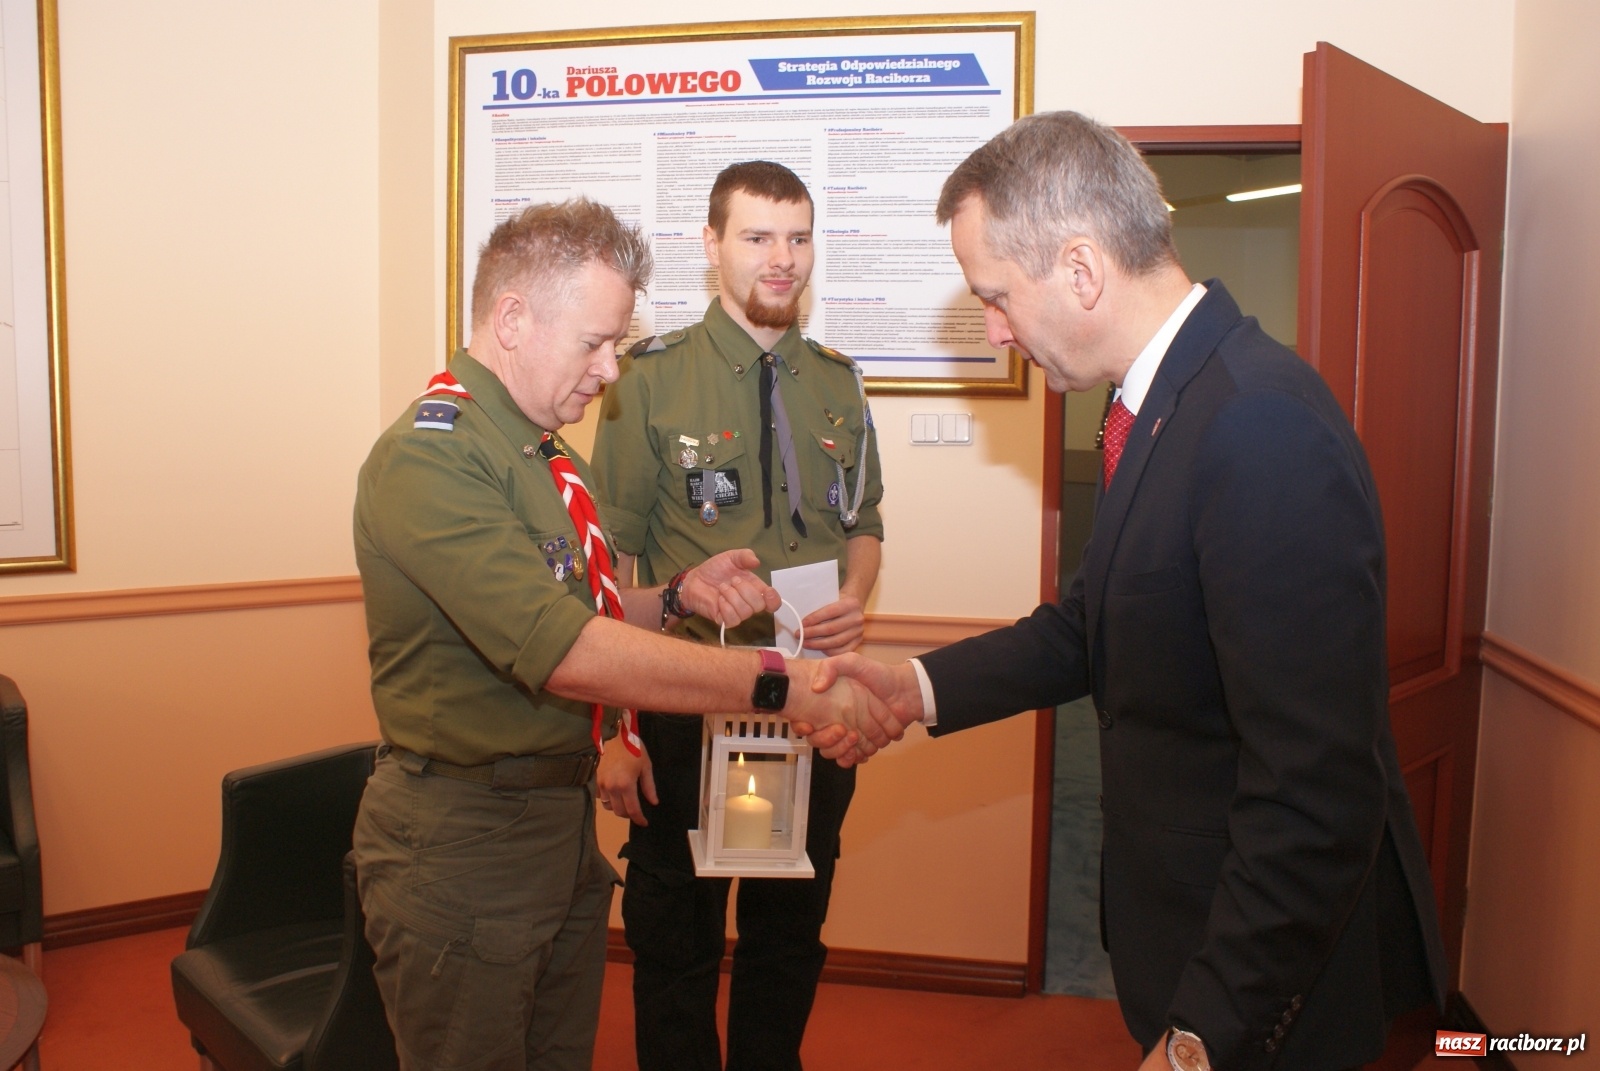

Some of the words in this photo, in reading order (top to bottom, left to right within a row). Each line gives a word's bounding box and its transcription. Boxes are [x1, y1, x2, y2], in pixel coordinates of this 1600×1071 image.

[566, 65, 618, 76] Dariusza
[778, 61, 838, 74] Strategia
[841, 58, 960, 73] Odpowiedzialnego
[566, 69, 741, 98] POLOWEGO
[806, 75, 862, 87] Rozwoju
[865, 72, 931, 85] Raciborza
